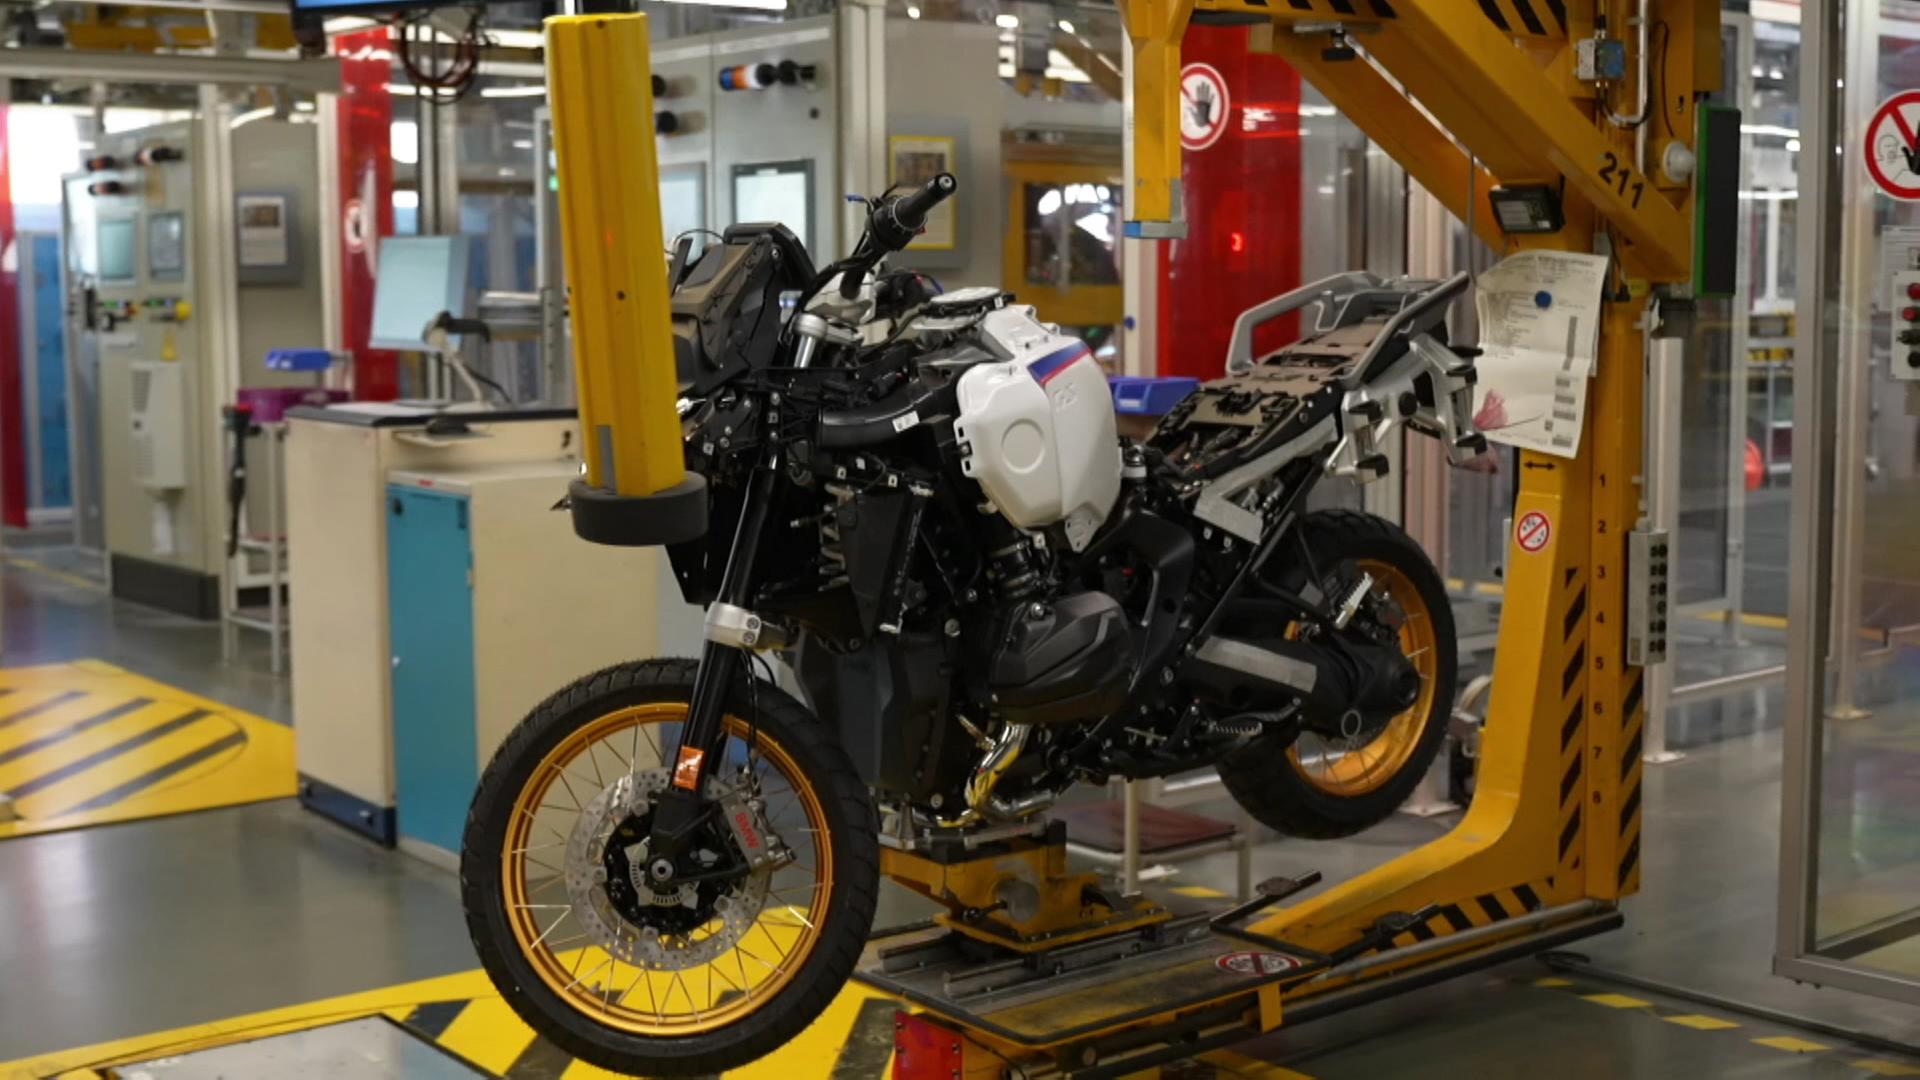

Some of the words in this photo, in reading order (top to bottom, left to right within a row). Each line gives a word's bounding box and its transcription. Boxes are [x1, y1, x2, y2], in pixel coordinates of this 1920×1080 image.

[1599, 151, 1644, 210] 211
[1599, 474, 1606, 487] 1
[1597, 520, 1606, 534] 2
[1597, 565, 1606, 579] 3
[1596, 611, 1605, 624] 4
[1595, 656, 1604, 670] 5
[1594, 702, 1603, 715] 6
[1593, 746, 1602, 759] 7
[1592, 791, 1601, 804] 8
[735, 812, 758, 848] BMW
